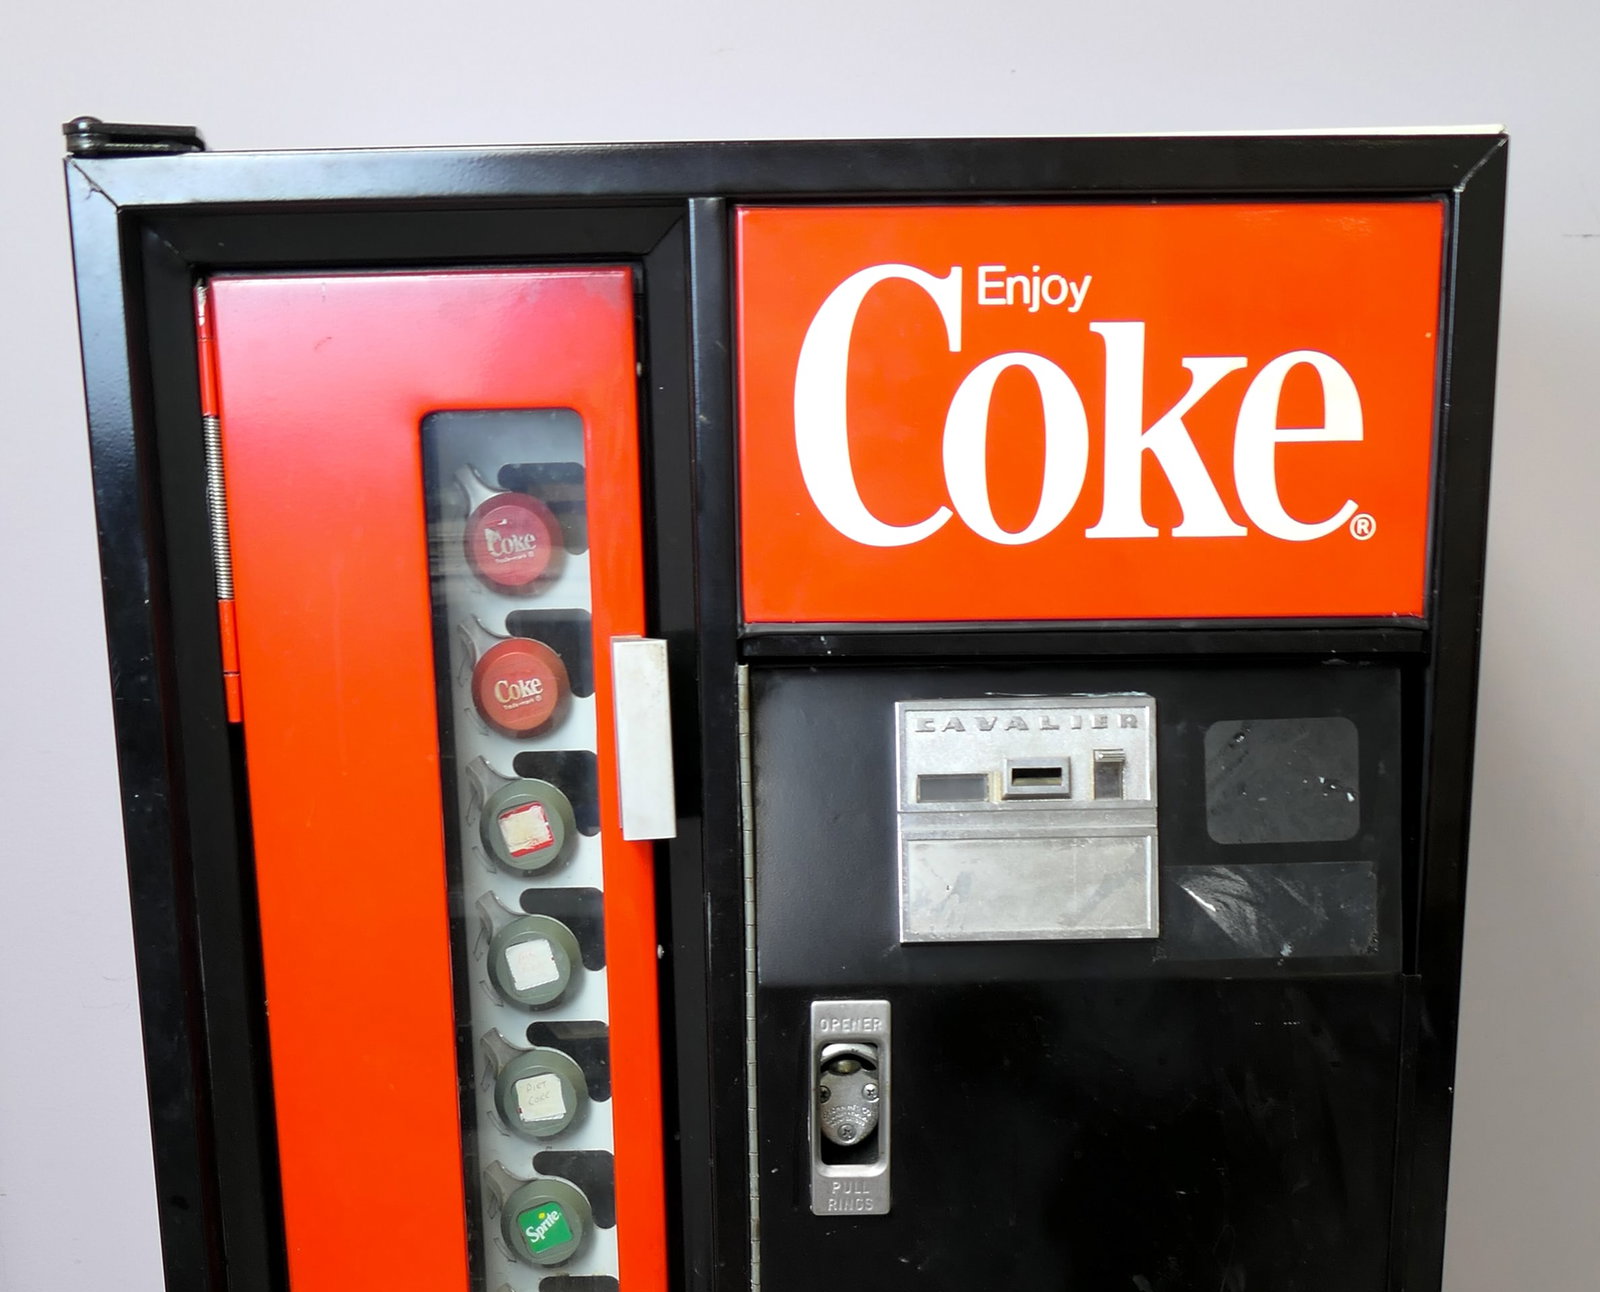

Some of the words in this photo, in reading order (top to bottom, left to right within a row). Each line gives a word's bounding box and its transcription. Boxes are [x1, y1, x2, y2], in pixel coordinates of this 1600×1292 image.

[977, 265, 1092, 311] Enjoy
[794, 263, 1364, 547] Coke
[485, 528, 537, 557] Coke
[495, 678, 544, 703] Coke
[914, 713, 1139, 733] CAVALIER
[819, 1017, 883, 1032] OPENER
[832, 1181, 870, 1194] PULL
[827, 1198, 874, 1212] RINGS
[525, 1210, 560, 1243] Sprite
